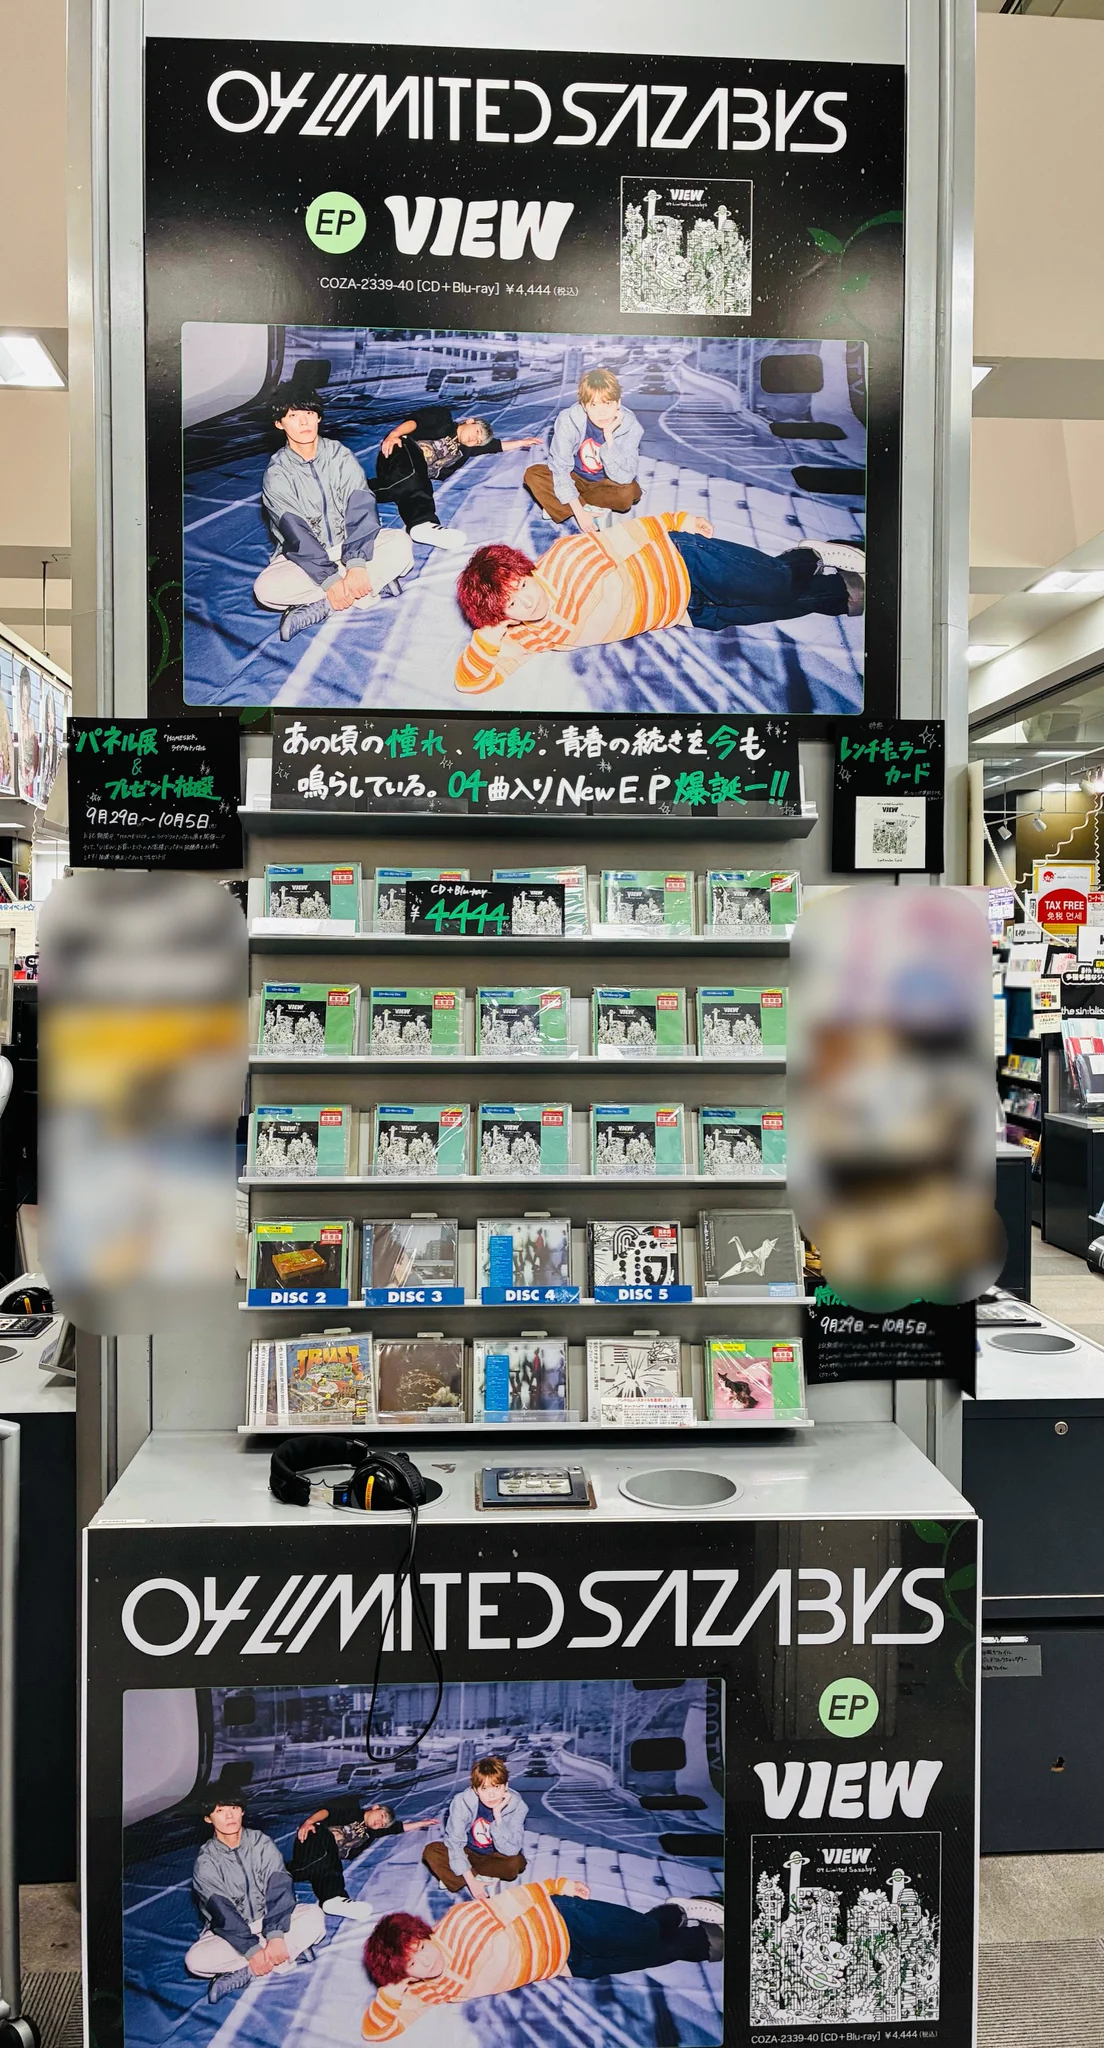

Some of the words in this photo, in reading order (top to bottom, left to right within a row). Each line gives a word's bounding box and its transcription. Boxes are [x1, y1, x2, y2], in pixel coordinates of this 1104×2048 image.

[300, 72, 550, 145] LIMITED
[555, 81, 847, 153] SAZABYS
[670, 189, 704, 201] VIEW
[315, 209, 356, 236] EP
[384, 195, 575, 261] VIEW
[320, 277, 414, 292] COZA-2339-40
[417, 279, 500, 296] [CD+Blu-ray]
[506, 284, 551, 296] ¥4,444
[75, 725, 158, 756] パネル展
[841, 737, 927, 762] レンチキュラー
[131, 758, 142, 775] &
[885, 763, 930, 785] カード
[105, 775, 220, 800] プレゼント抽選
[1045, 901, 1061, 910] TAX
[1063, 901, 1084, 910] FREE
[1047, 912, 1063, 920] 免税
[1066, 912, 1082, 920] 면세
[271, 1291, 308, 1304] DISC
[315, 1291, 327, 1304] 2
[388, 1291, 425, 1303] DISC
[431, 1291, 443, 1302] 3
[505, 1289, 539, 1301] DISC
[544, 1289, 556, 1301] 4
[618, 1289, 653, 1300] DISC
[659, 1289, 669, 1300] 5
[296, 1344, 361, 1380] TRUST
[240, 1572, 564, 1654] LIMITED
[567, 1567, 946, 1649] SAZABYS
[828, 1695, 869, 1720] EP
[753, 1760, 943, 1820] VIEW
[822, 1848, 872, 1864] VIEW
[751, 2034, 819, 2044] COZA-2339-40
[821, 2032, 881, 2042] [CD+Blu-ray]
